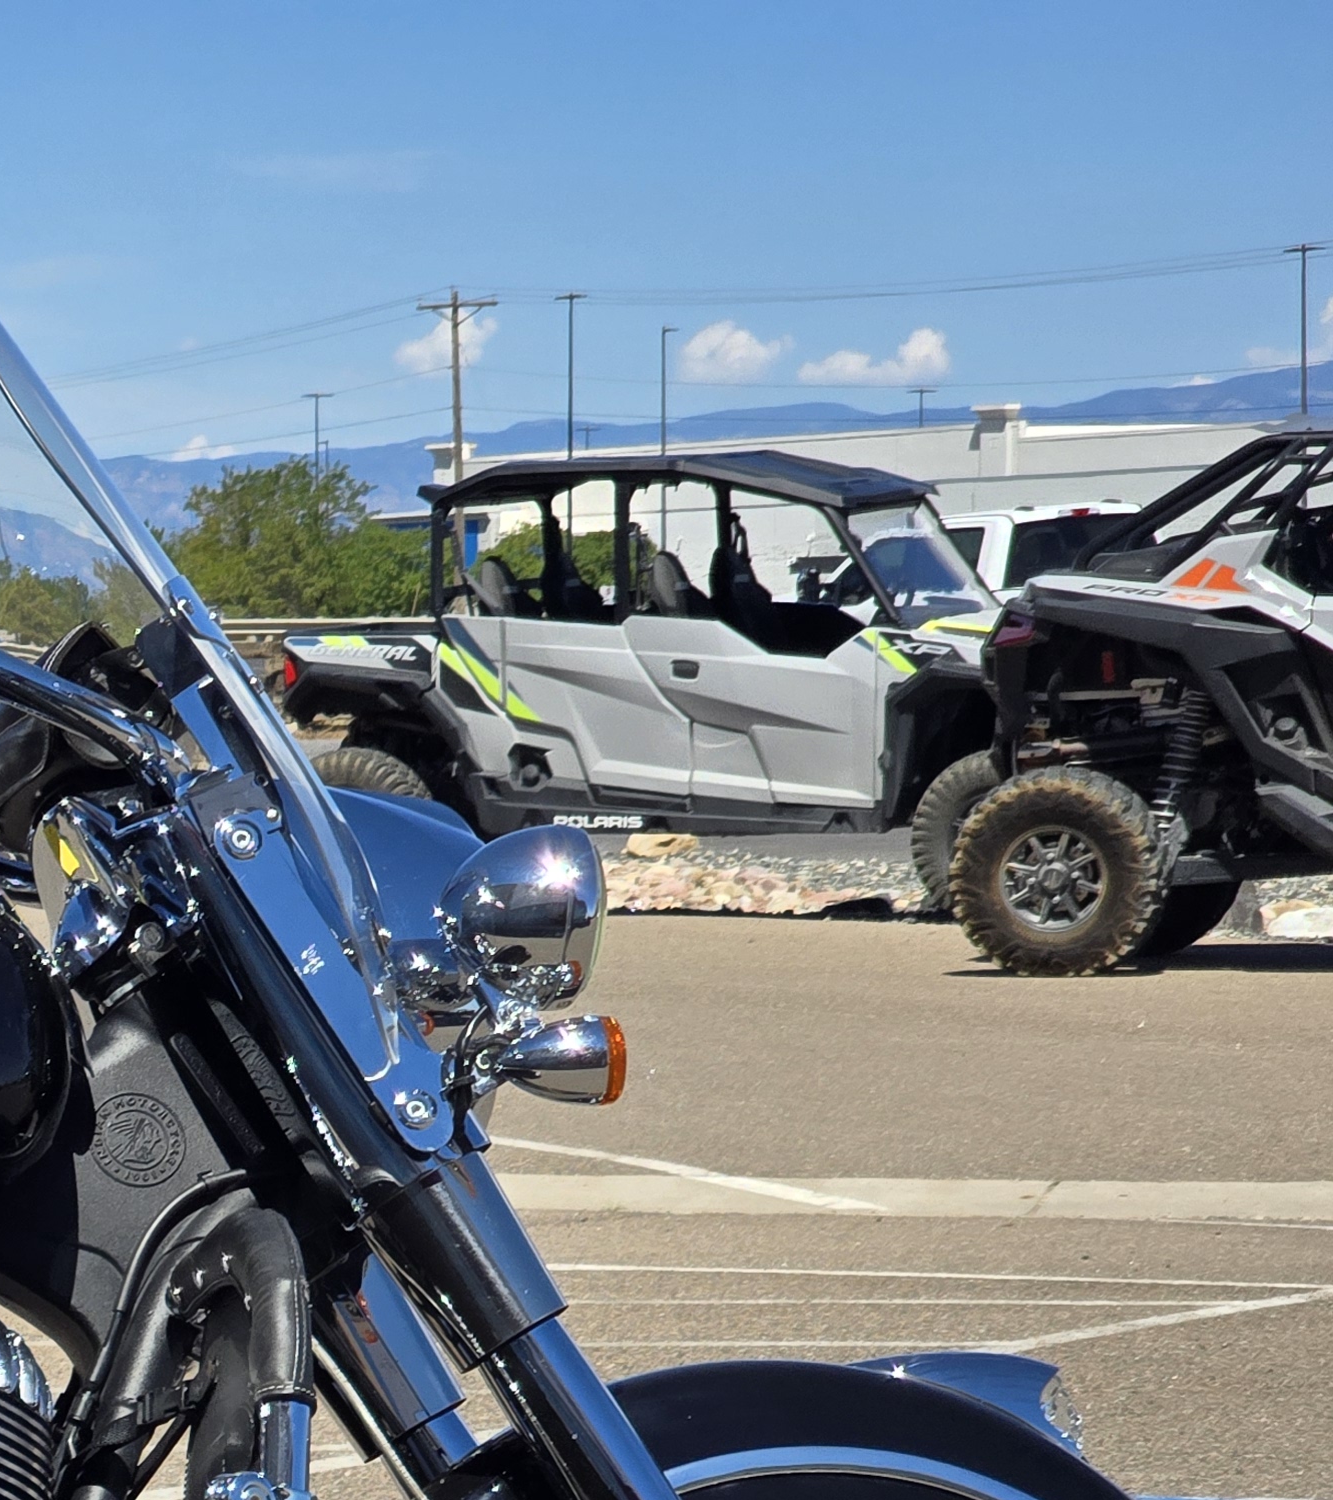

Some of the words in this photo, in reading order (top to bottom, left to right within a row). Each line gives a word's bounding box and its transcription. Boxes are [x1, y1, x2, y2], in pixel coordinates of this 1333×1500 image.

[1083, 584, 1169, 597] PRO
[310, 643, 417, 661] GENERAL
[889, 639, 952, 655] XP
[553, 815, 643, 829] POLARIS
